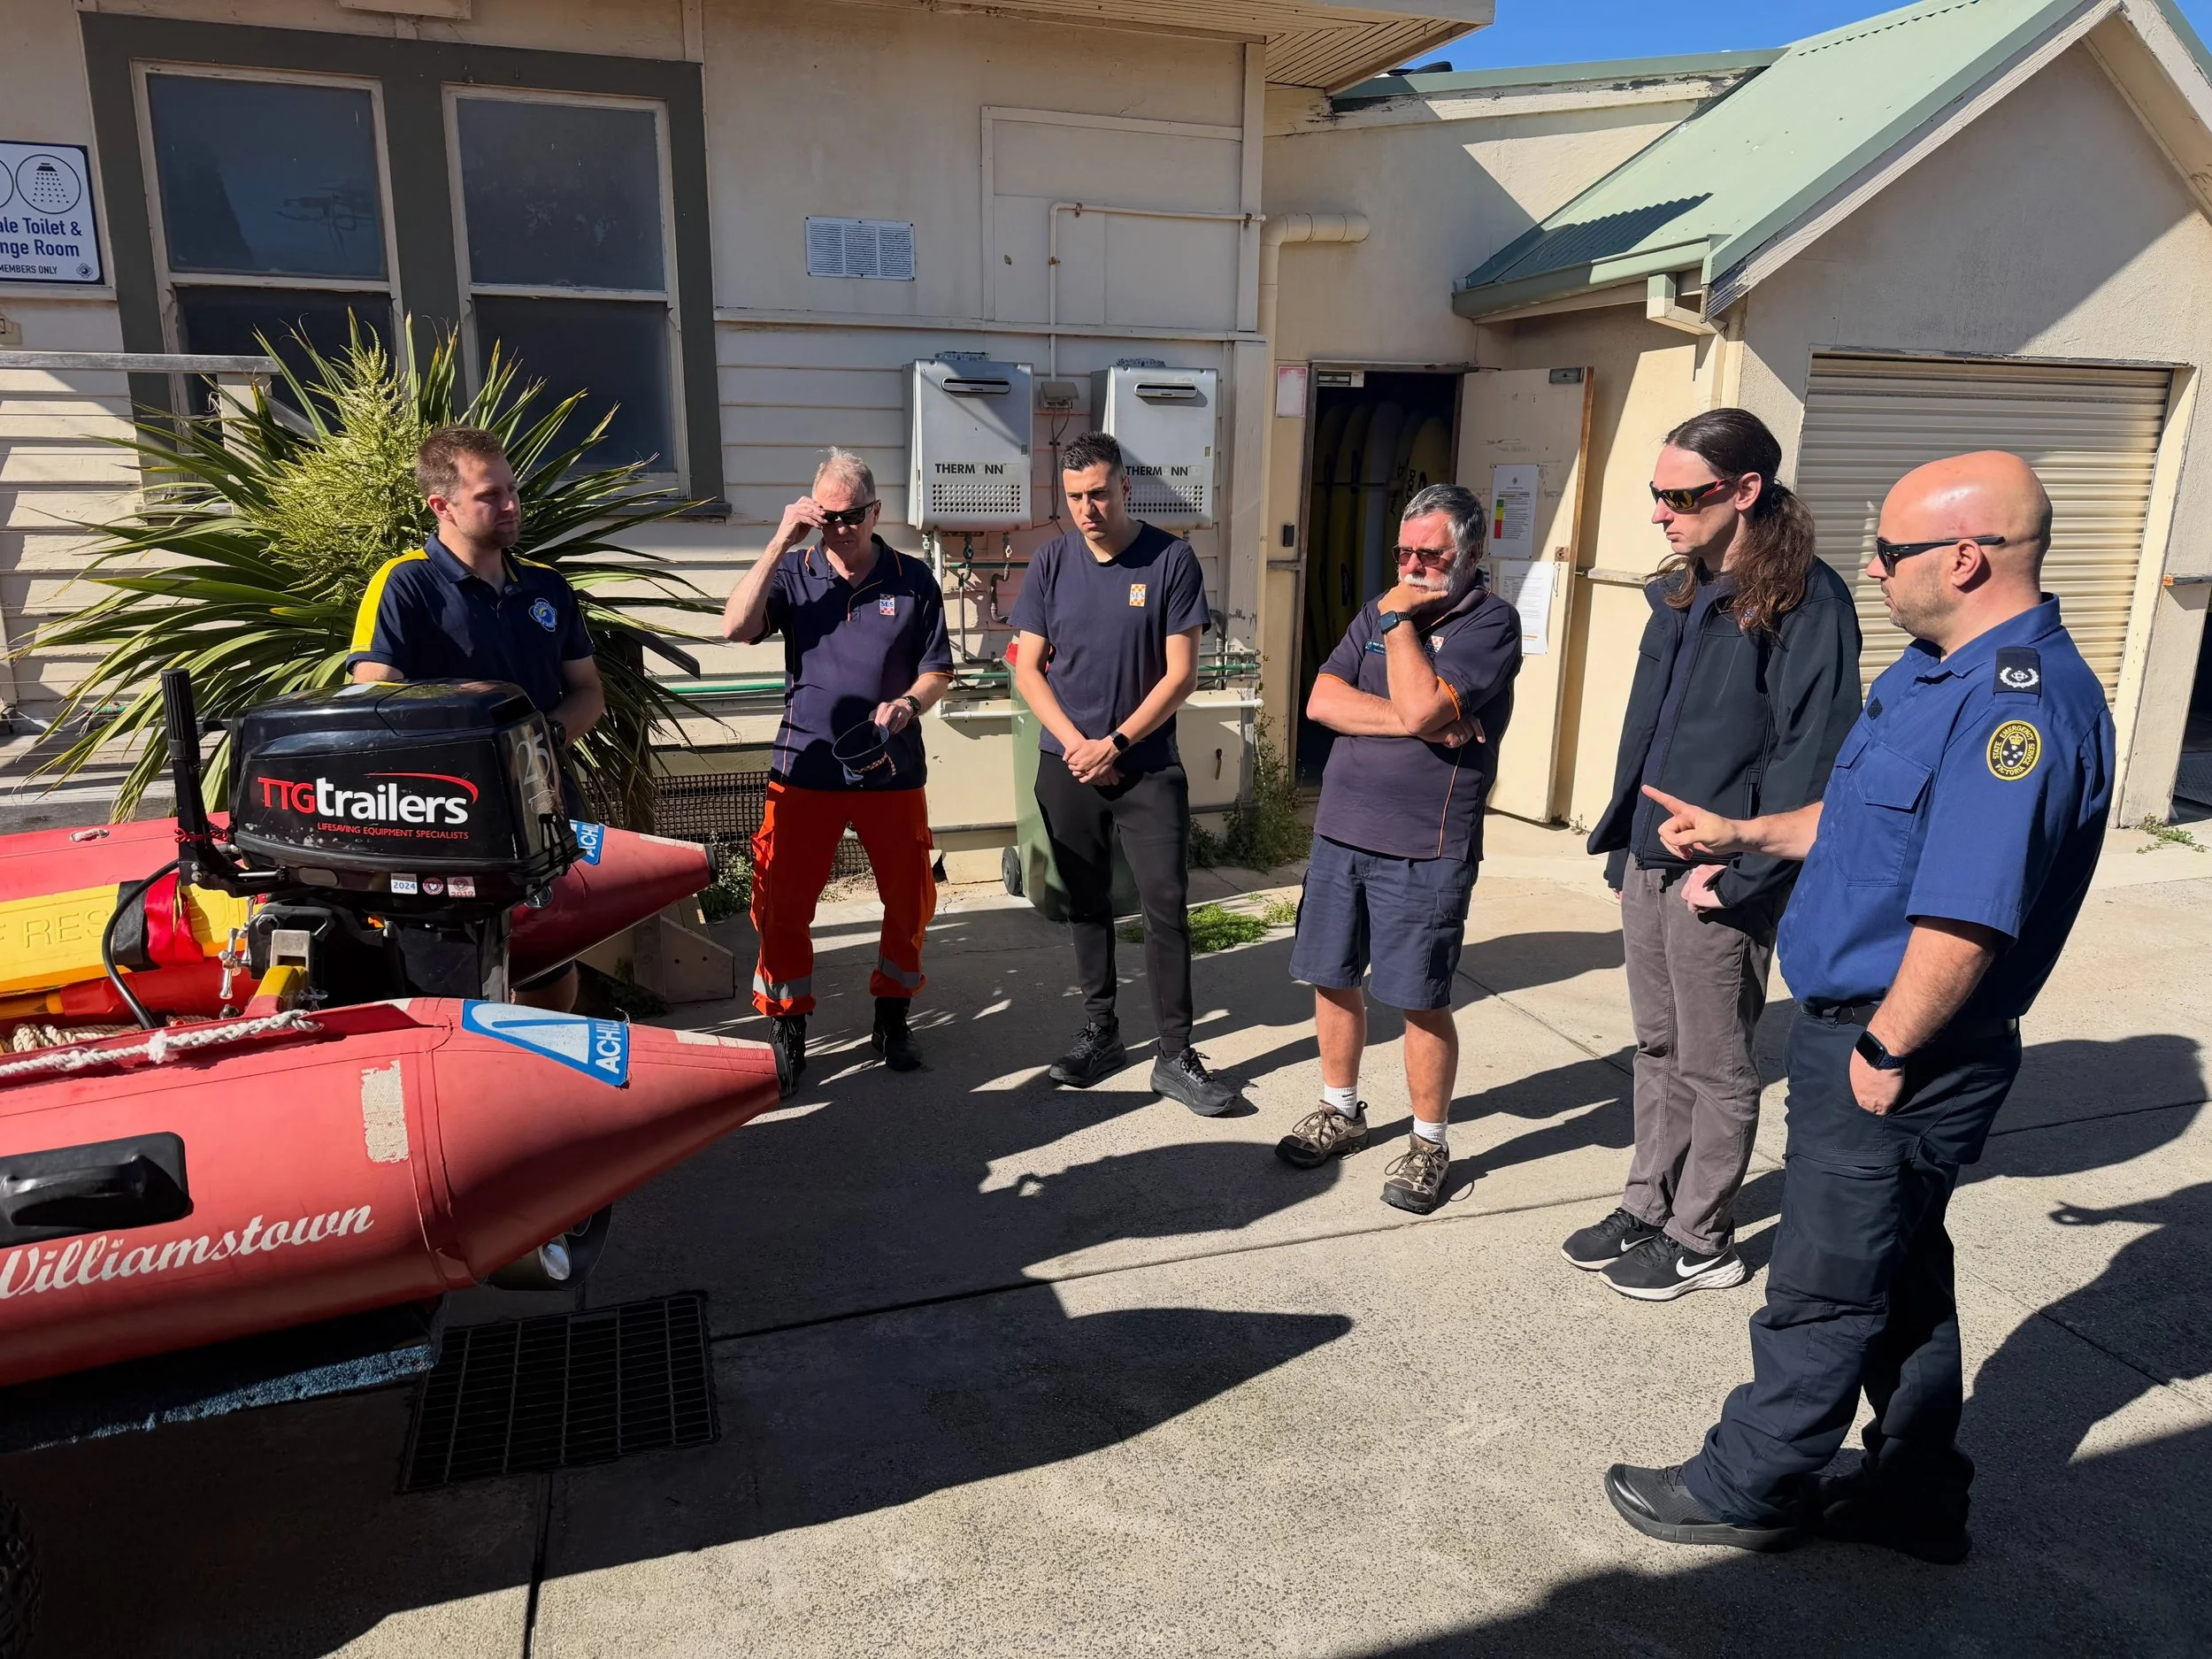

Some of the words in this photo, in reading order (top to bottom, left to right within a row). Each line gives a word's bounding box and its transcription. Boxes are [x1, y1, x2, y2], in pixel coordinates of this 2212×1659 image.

[22, 218, 66, 234] Toilet
[71, 221, 82, 236] &
[34, 239, 80, 257] Room
[38, 265, 58, 274] ONLY
[1992, 741, 2002, 760] STATE
[2000, 725, 2035, 741] EMERGENCY
[2023, 742, 2035, 766] SERVICE
[1994, 764, 2026, 776] VICTORIA
[317, 822, 361, 834] LIFESAVING
[363, 826, 412, 838] EQUIPMENT
[416, 829, 469, 840] SPECIALISTS
[393, 881, 416, 890] 2024
